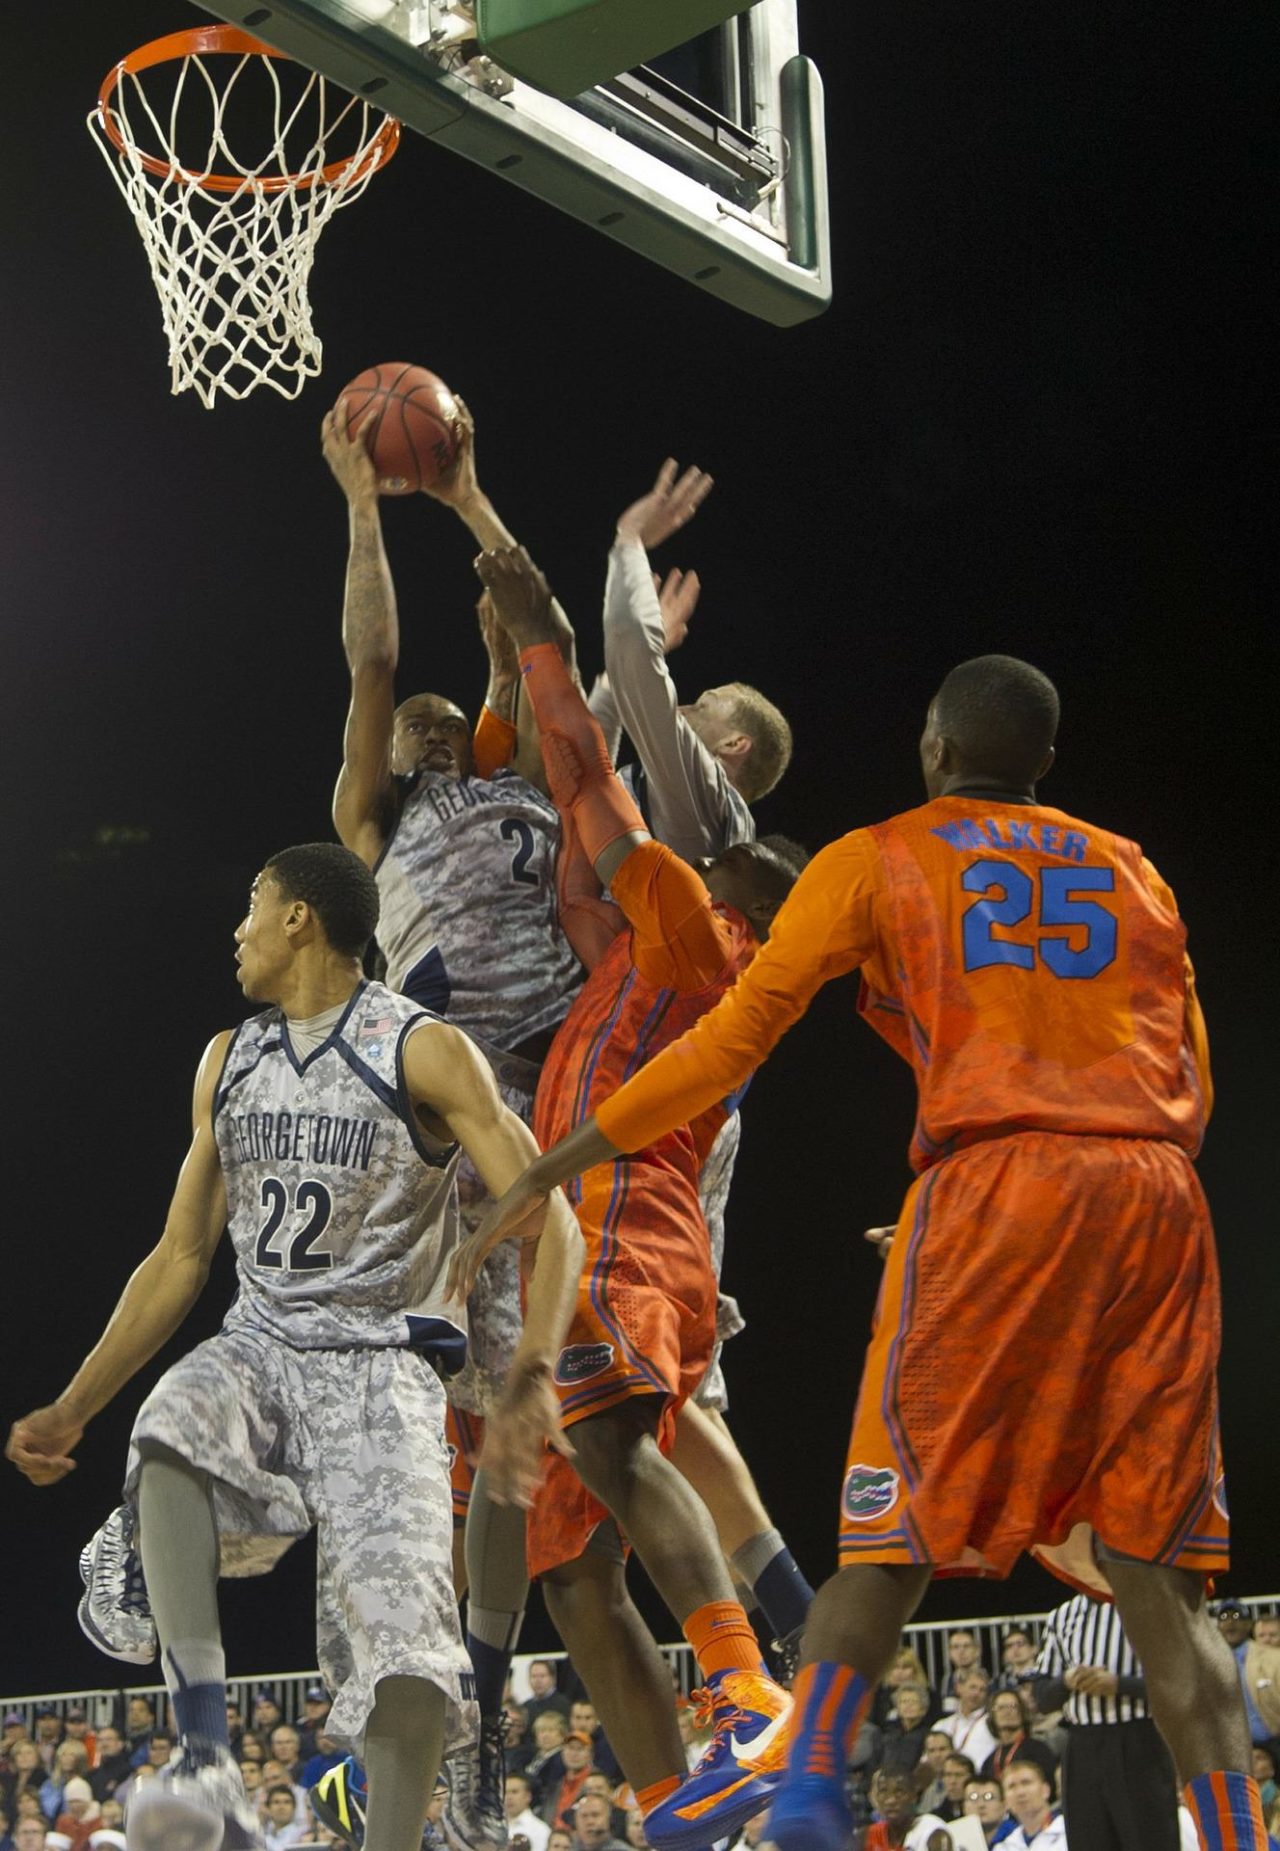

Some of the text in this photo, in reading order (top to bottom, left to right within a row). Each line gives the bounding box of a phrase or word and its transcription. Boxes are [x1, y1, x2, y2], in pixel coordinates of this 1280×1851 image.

[500, 816, 541, 887] 2
[930, 818, 1089, 864] WALKER
[961, 858, 1118, 980] 25
[255, 1175, 334, 1272] 22
